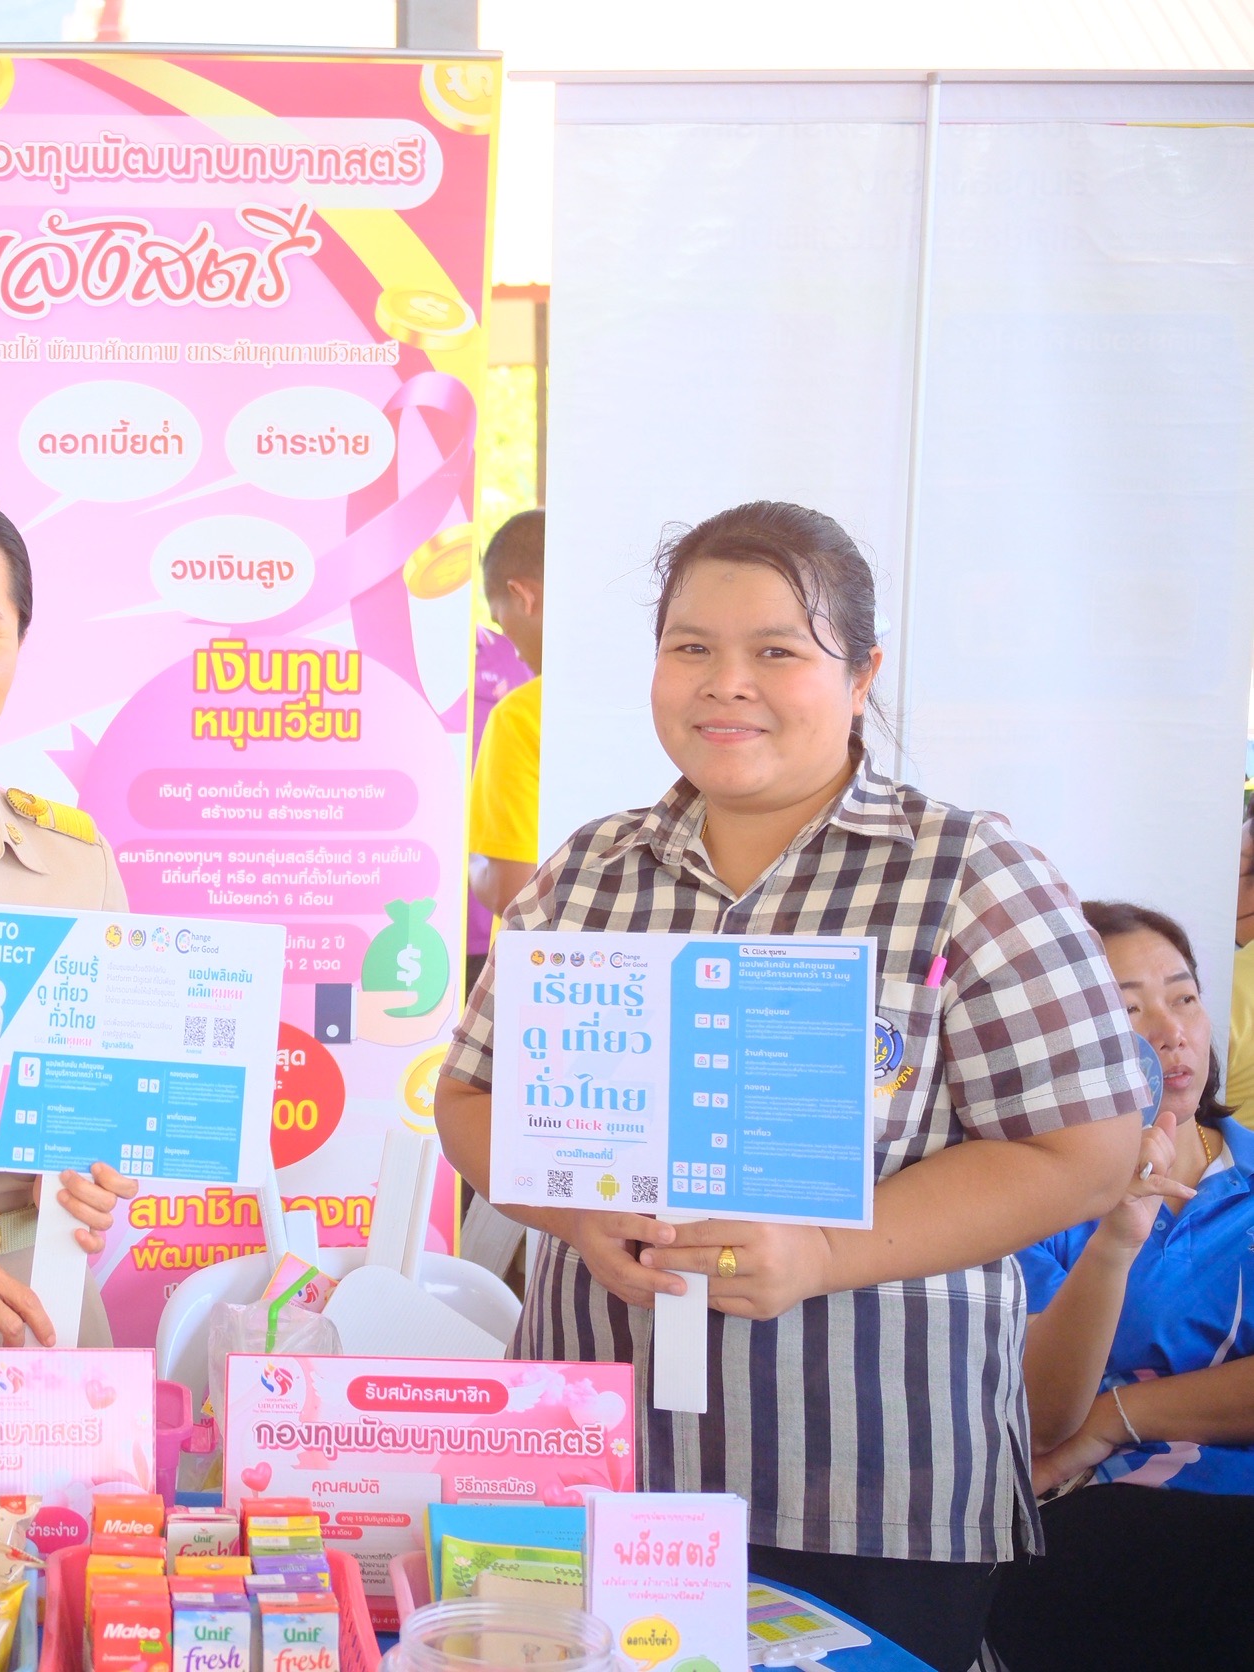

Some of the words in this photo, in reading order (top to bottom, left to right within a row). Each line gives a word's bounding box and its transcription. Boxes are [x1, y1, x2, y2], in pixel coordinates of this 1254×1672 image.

[47, 336, 179, 362] พัฒนาศักยภาพ
[187, 340, 397, 366] ยกระดับคุณภาพชีวิตสตรี
[38, 420, 184, 456] ดอกเบี้ยต่ำ
[256, 426, 370, 456] ชำระง่าย
[170, 554, 295, 589] วงเงินสูง
[195, 640, 360, 706] เงินทุน
[194, 701, 359, 749] หมุนเวียน
[159, 783, 192, 801] เงินกู้
[197, 781, 269, 800] ดอกเบี้ยต่ำ
[275, 783, 385, 800] เพื่อพัฒนาอาชีพ
[201, 804, 262, 820] สร้างงาน
[268, 805, 344, 820] สร้างรายได้
[118, 848, 223, 867] สมาชิกกองทุนฯ
[228, 846, 353, 868] รวมกลุ่มสตรีตั้งแต่
[357, 852, 366, 864] 3
[371, 847, 422, 864] คนขึ้นไป
[162, 870, 222, 889] มีถิ่นที่อยู่
[227, 870, 257, 885] หรือ
[262, 868, 381, 886] สถานที่ตั้งในท้องที่
[208, 888, 279, 906] ไม่น้อยกว่า
[284, 894, 293, 906] 6
[299, 890, 334, 906] เดือน
[190, 945, 200, 953] for
[201, 944, 220, 954] Good
[321, 938, 330, 949] 2
[334, 935, 345, 950] ปี
[751, 948, 767, 956] Click
[54, 954, 100, 983] เรียนรู้
[188, 966, 253, 984] แอปพลิเคชัน
[298, 960, 308, 971] 2
[313, 959, 341, 971] งวด
[632, 961, 649, 969] Good
[821, 971, 832, 980] 13
[834, 972, 851, 982] เมนู
[36, 984, 48, 1006] ดู
[52, 975, 89, 1003] เที่ยว
[533, 972, 647, 1017] เรียนรู้
[49, 1002, 96, 1030] ทั่วไทย
[522, 1026, 548, 1060] ดู
[561, 1011, 652, 1055] เที่ยว
[275, 1048, 306, 1072] สุด
[524, 1066, 647, 1113] ทั่วไทย
[527, 1114, 562, 1130] ไปกับ
[566, 1117, 602, 1132] Click
[606, 1121, 645, 1135] ชุมชน
[556, 1146, 614, 1161] ดาวน์โหลดที่นี่
[513, 1174, 534, 1188] iOS
[365, 1383, 491, 1404] รับสมัครสมาชิก
[254, 1417, 603, 1458] กองทุนพัฒนาบทบาทสตรี
[311, 1478, 381, 1497] คุณสมบัติ
[454, 1475, 536, 1496] วิธีการสมัคร
[28, 1519, 79, 1539] ชำระง่าย
[103, 1520, 155, 1534] Malee
[341, 1515, 353, 1524] อายุ
[192, 1534, 213, 1544] Unif
[337, 1528, 353, 1536] เดือน
[613, 1529, 721, 1568] พลังสตรี
[103, 1623, 161, 1640] Malee
[194, 1625, 234, 1642] Unif
[283, 1626, 322, 1643] Unif
[626, 1629, 673, 1647] ดอกเบี้ยต่ำ
[183, 1645, 243, 1672] fresh
[273, 1647, 334, 1672] fresh
